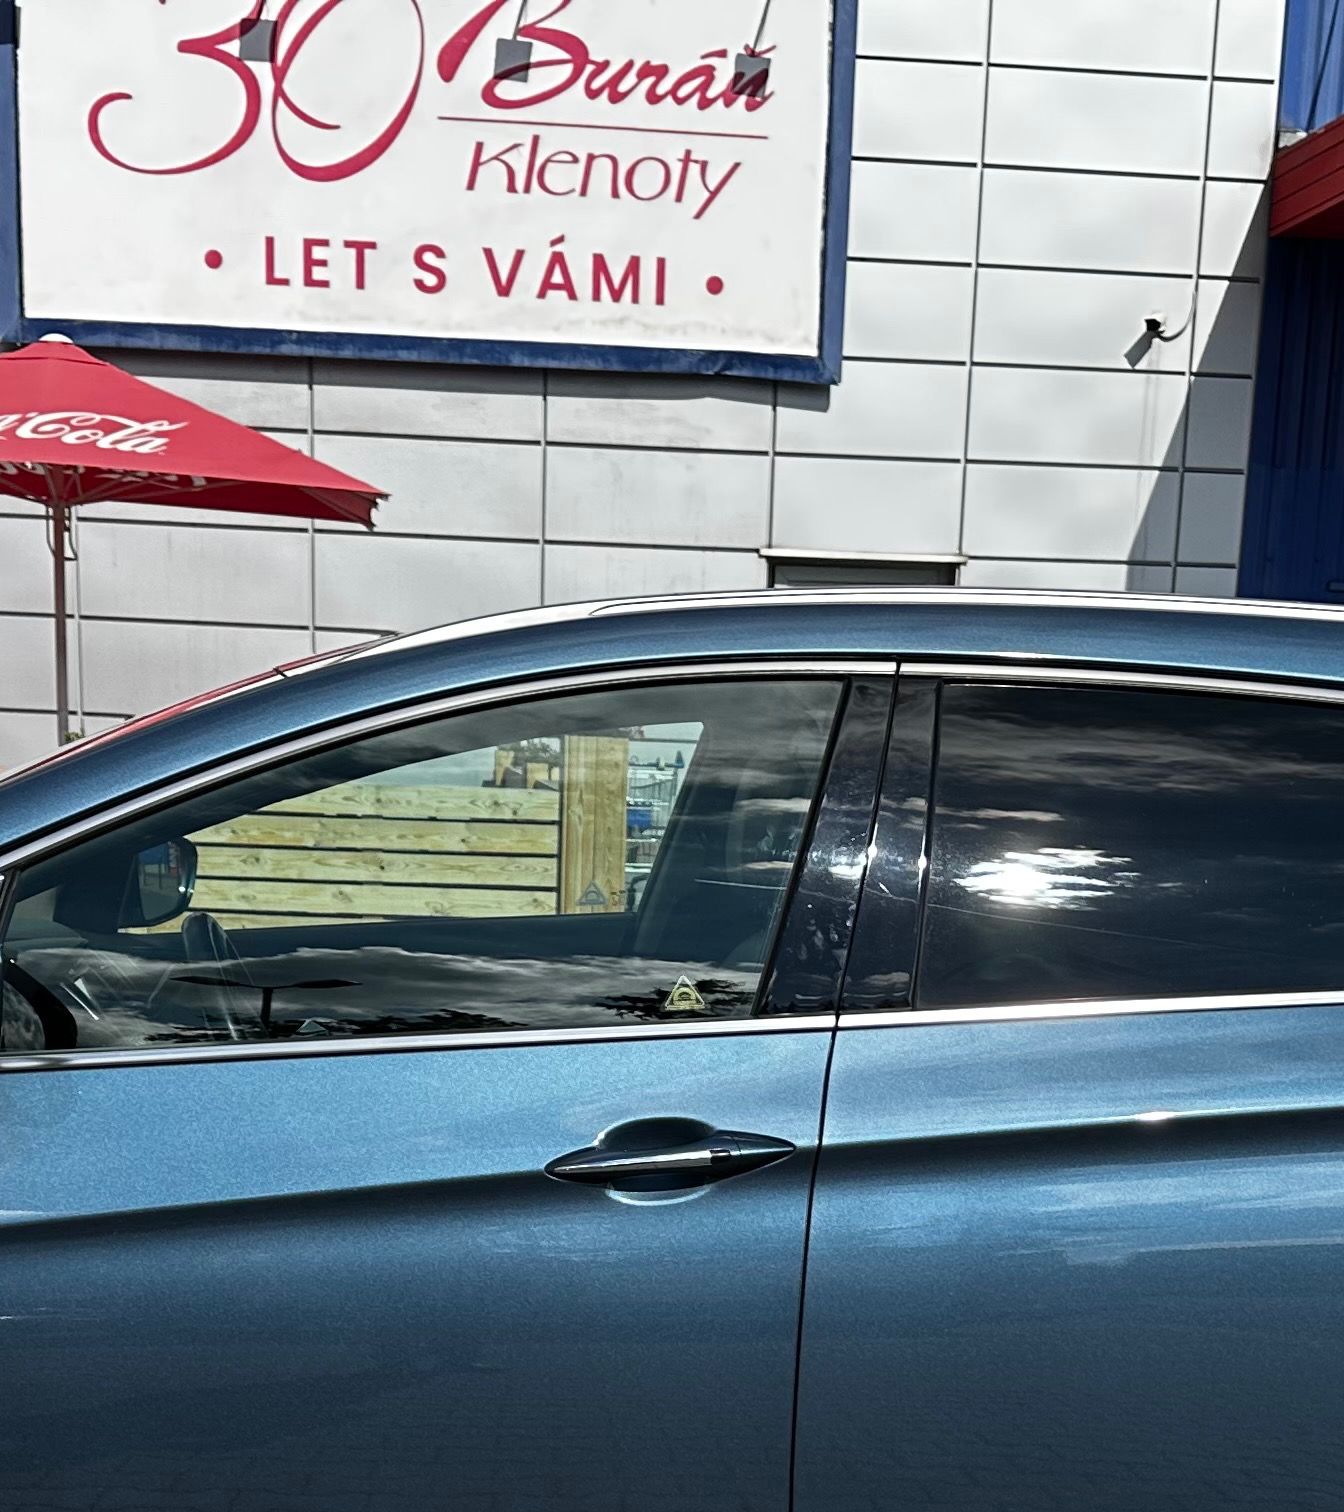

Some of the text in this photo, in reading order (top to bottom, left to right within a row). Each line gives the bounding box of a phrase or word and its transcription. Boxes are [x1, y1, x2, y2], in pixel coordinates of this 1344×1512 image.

[88, 0, 424, 181] 30
[466, 134, 742, 220] Klenoty
[265, 234, 666, 306] LET S VÁMI
